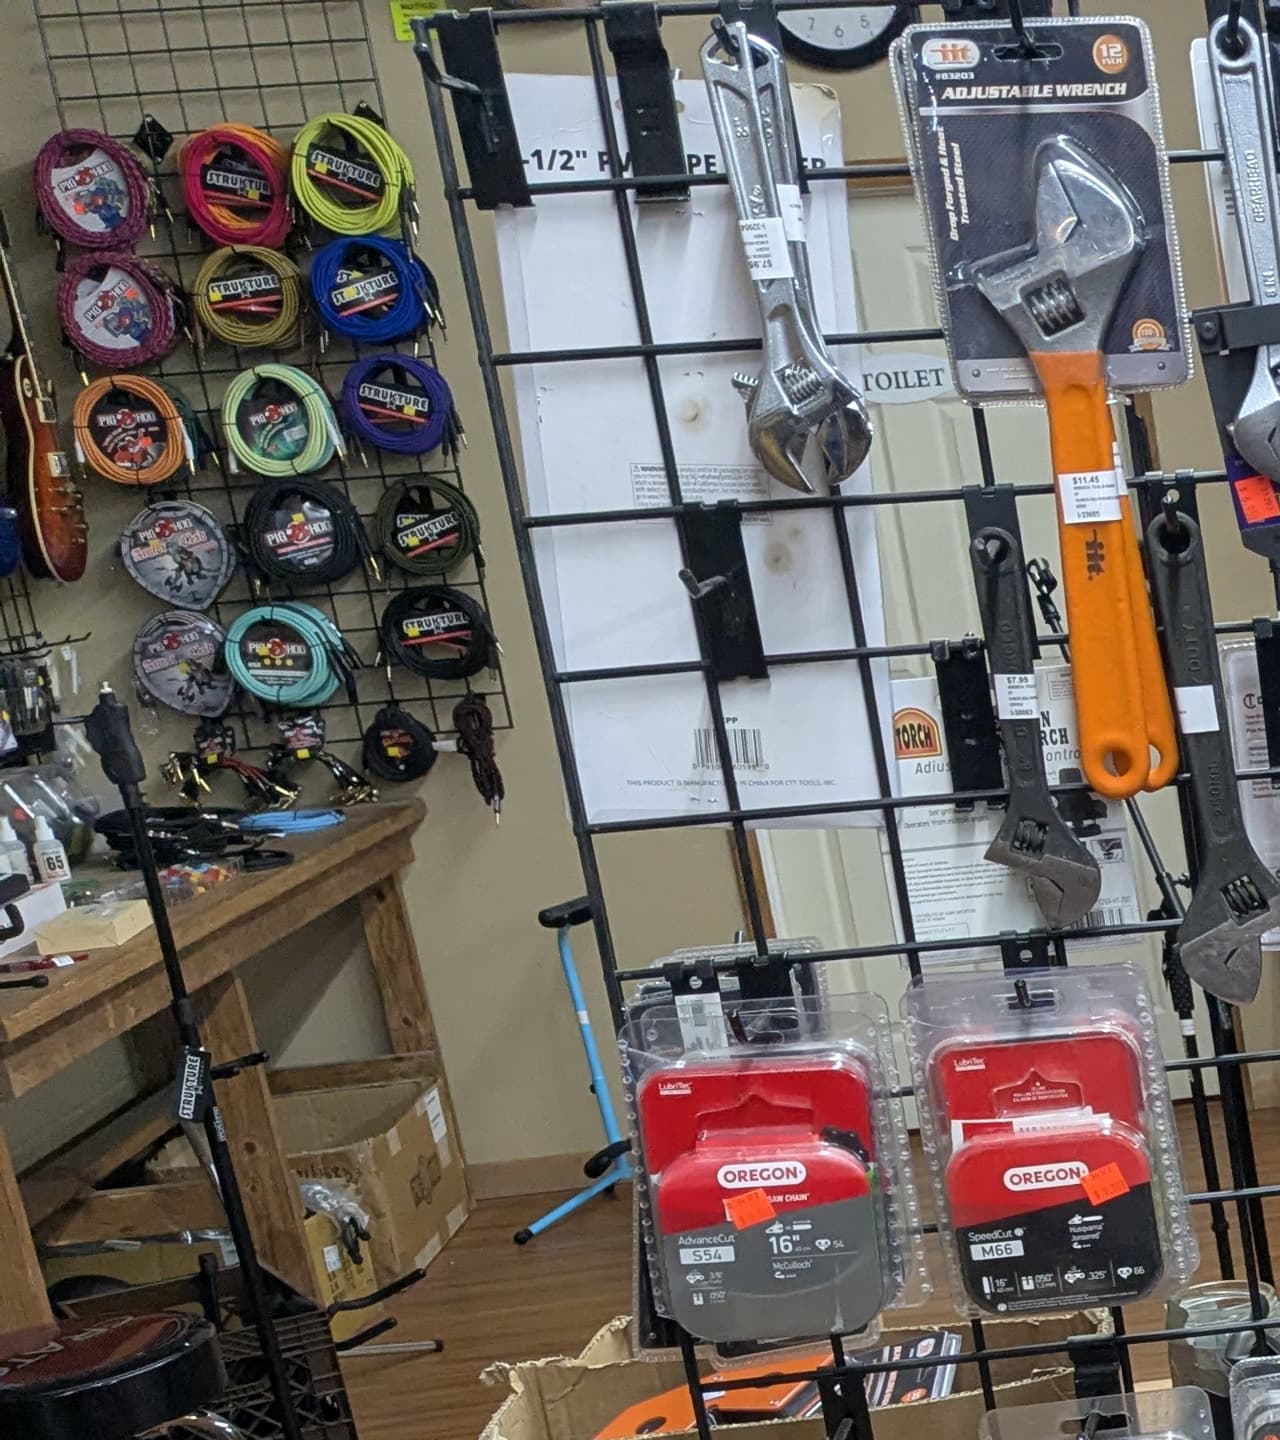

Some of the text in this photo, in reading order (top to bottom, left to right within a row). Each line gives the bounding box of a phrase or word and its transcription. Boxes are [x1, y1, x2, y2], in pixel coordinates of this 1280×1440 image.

[808, 16, 815, 30] 7
[835, 24, 844, 38] 6
[860, 15, 870, 29] 5
[1100, 44, 1123, 59] 12
[941, 82, 1128, 100] ADJUSTABLE WRENCH
[311, 149, 381, 188] STRUKTURE
[206, 170, 272, 193] STRUKTUR
[950, 142, 970, 224] Treated Steel
[948, 211, 959, 241] Drop
[209, 274, 279, 296] STRUKTURE
[331, 271, 399, 306] STUKTURE
[863, 367, 945, 392] TOILET
[359, 384, 430, 412] STRUKTURE
[1072, 475, 1100, 485] $11.45
[266, 530, 287, 546] PIG
[46, 854, 66, 872] 65
[178, 1054, 202, 1122] STRUKTURE
[723, 1166, 799, 1184] OREGON
[1009, 1167, 1082, 1186] OREGON
[678, 1233, 735, 1246] AdvanceCut
[767, 1234, 801, 1254] 16"
[968, 1229, 1013, 1242] SpeedCut
[692, 1248, 722, 1263] S54
[981, 1243, 1013, 1257] M66
[1133, 1266, 1145, 1275] 66
